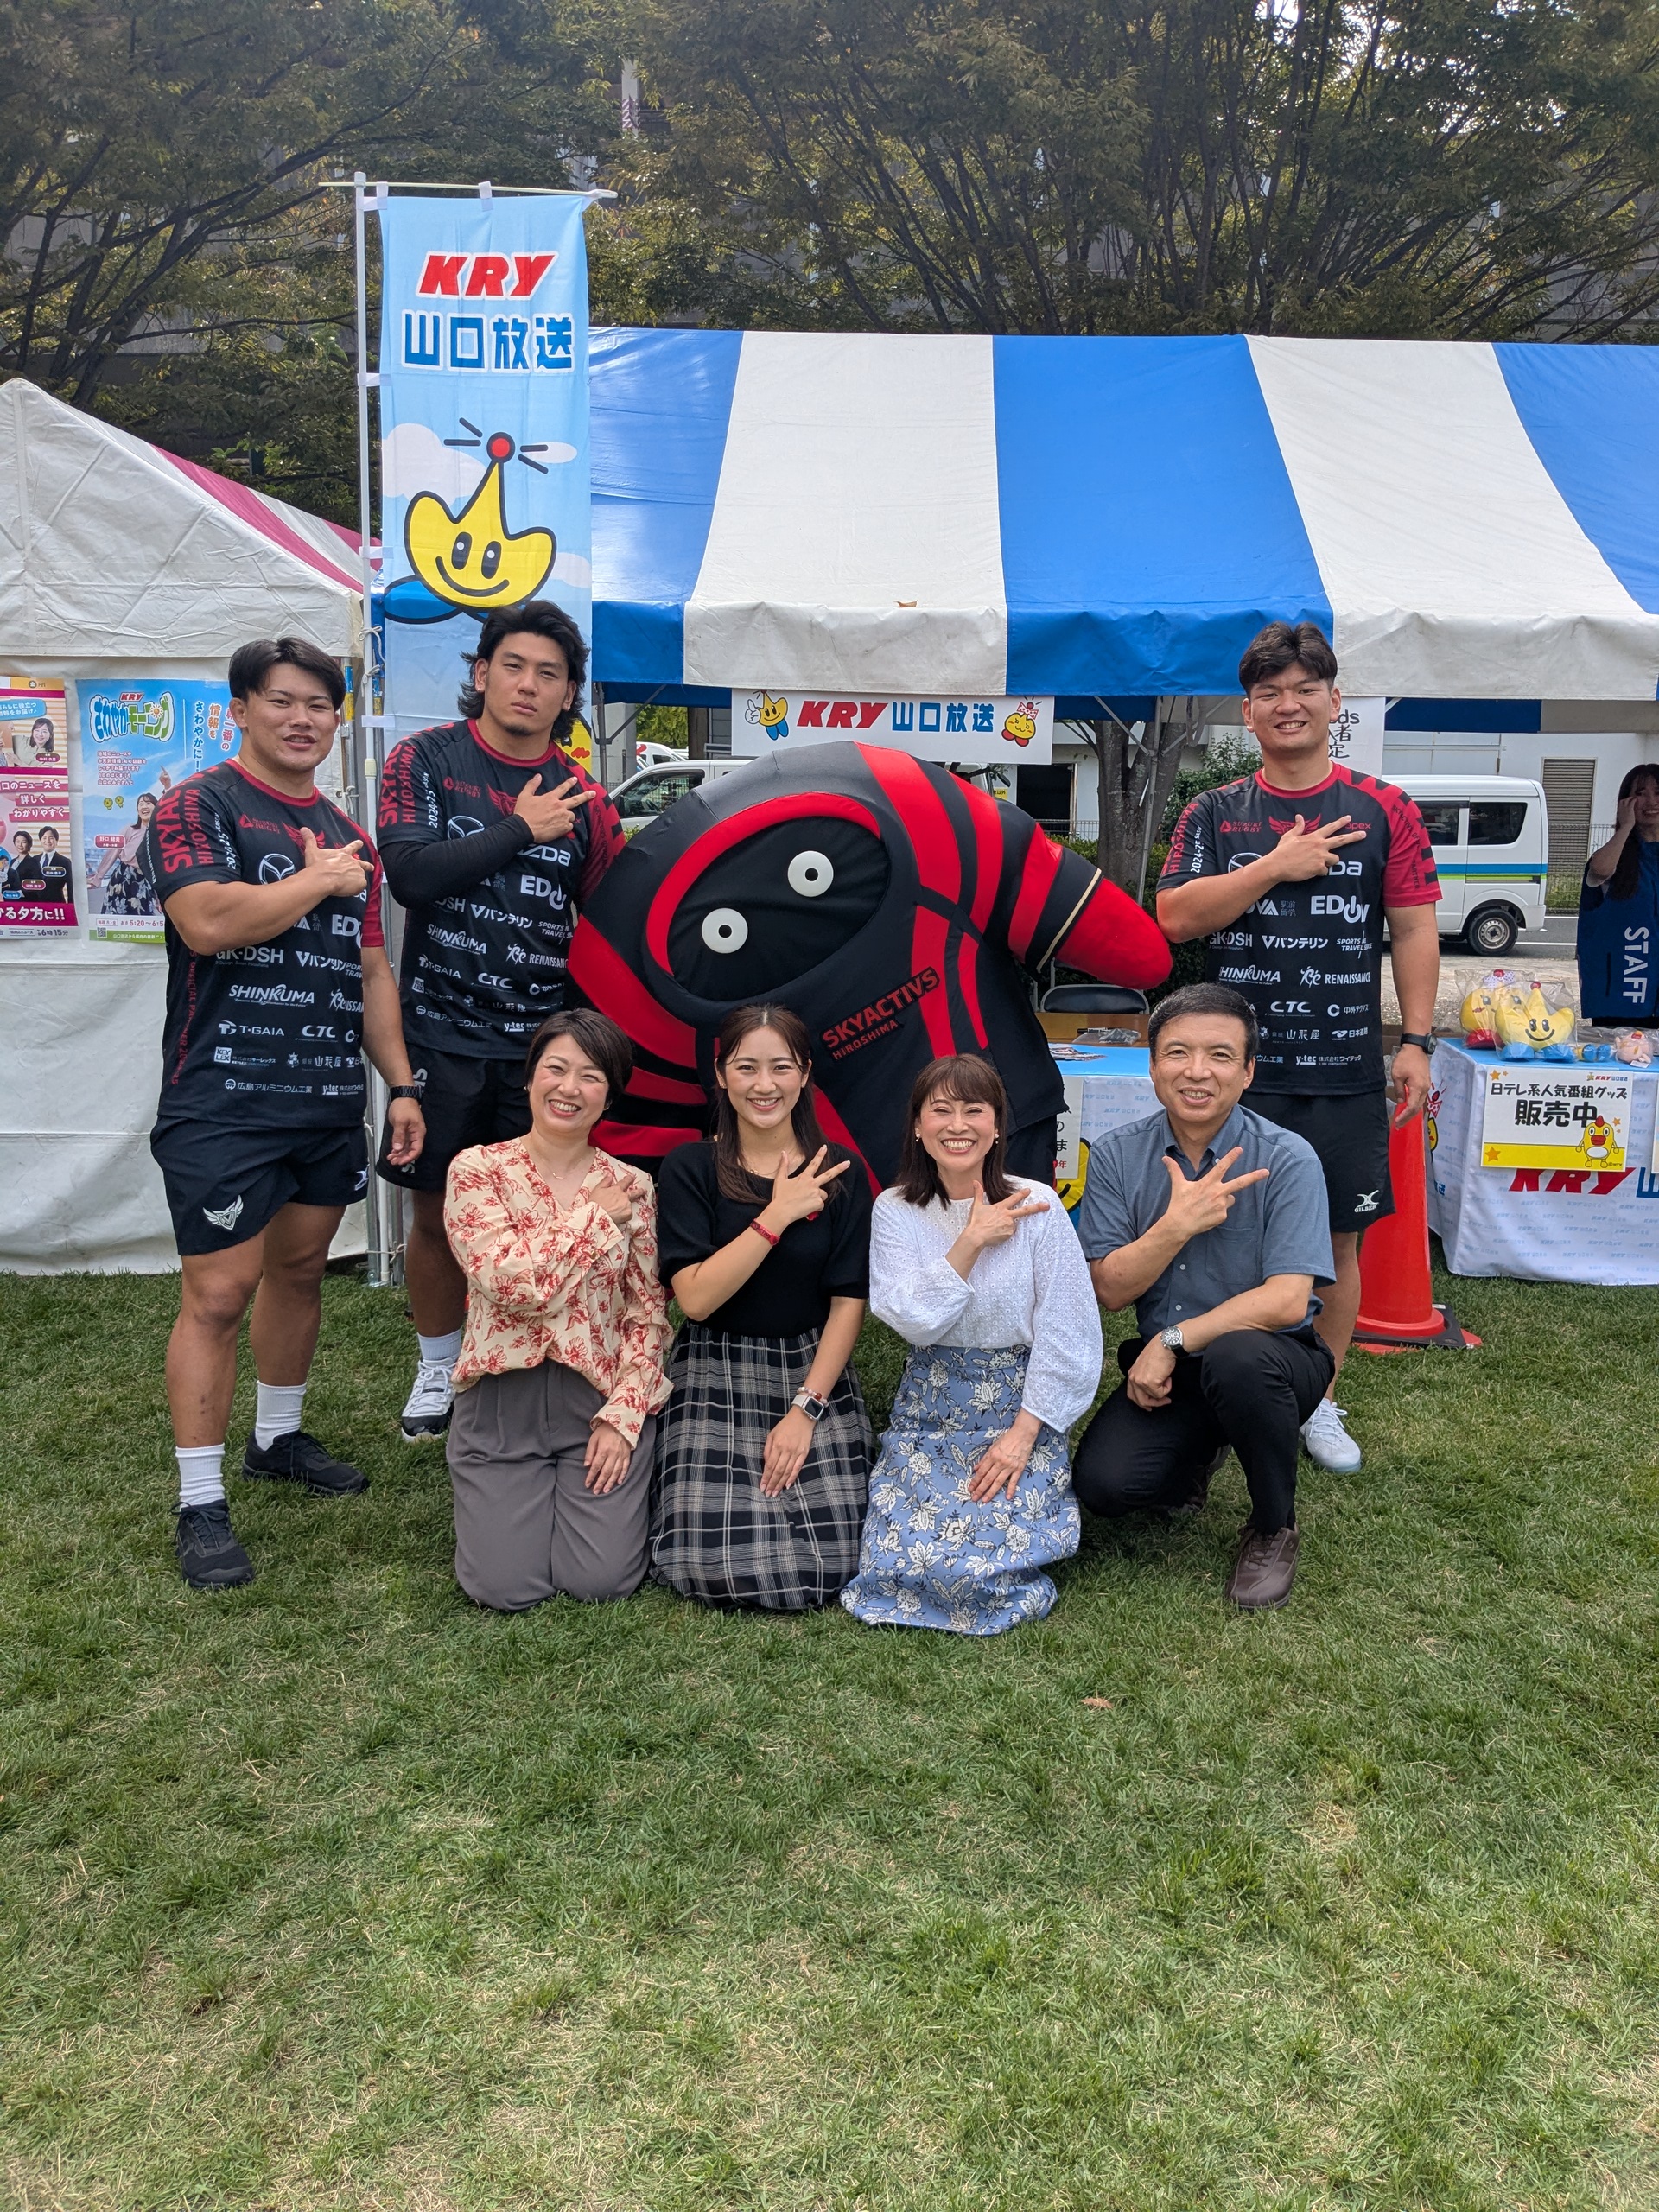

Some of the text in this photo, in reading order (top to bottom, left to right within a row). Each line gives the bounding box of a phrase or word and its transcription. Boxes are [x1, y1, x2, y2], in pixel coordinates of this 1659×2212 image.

[419, 255, 555, 296] KRY
[404, 313, 572, 370] 山口放送
[208, 704, 221, 739] 情報を
[797, 701, 994, 732] KRY 山口放送
[0, 780, 60, 790] 口のニュースを
[399, 745, 416, 823] HIROSHIMA
[13, 807, 66, 817] わかりやすく
[20, 794, 45, 804] 詳しく
[156, 787, 193, 874] SKYAC
[184, 789, 214, 865] HIROSHIMA
[426, 924, 486, 954] SHINKUMA
[1325, 972, 1371, 985] RENAISSANCE
[1623, 926, 1649, 1004] STAFF
[229, 984, 315, 1004] SHINKUMA
[478, 972, 512, 989] CTC
[823, 969, 938, 1048] SKYACTIVS
[1270, 1001, 1312, 1013] CTC
[302, 1025, 336, 1038] CTC
[832, 1020, 898, 1060] HIROSHIMA
[237, 1082, 313, 1094] 広島アルミニウム工業
[1491, 1082, 1628, 1099] 日テレ系人気番組グッズ
[1515, 1099, 1598, 1128] 販売中
